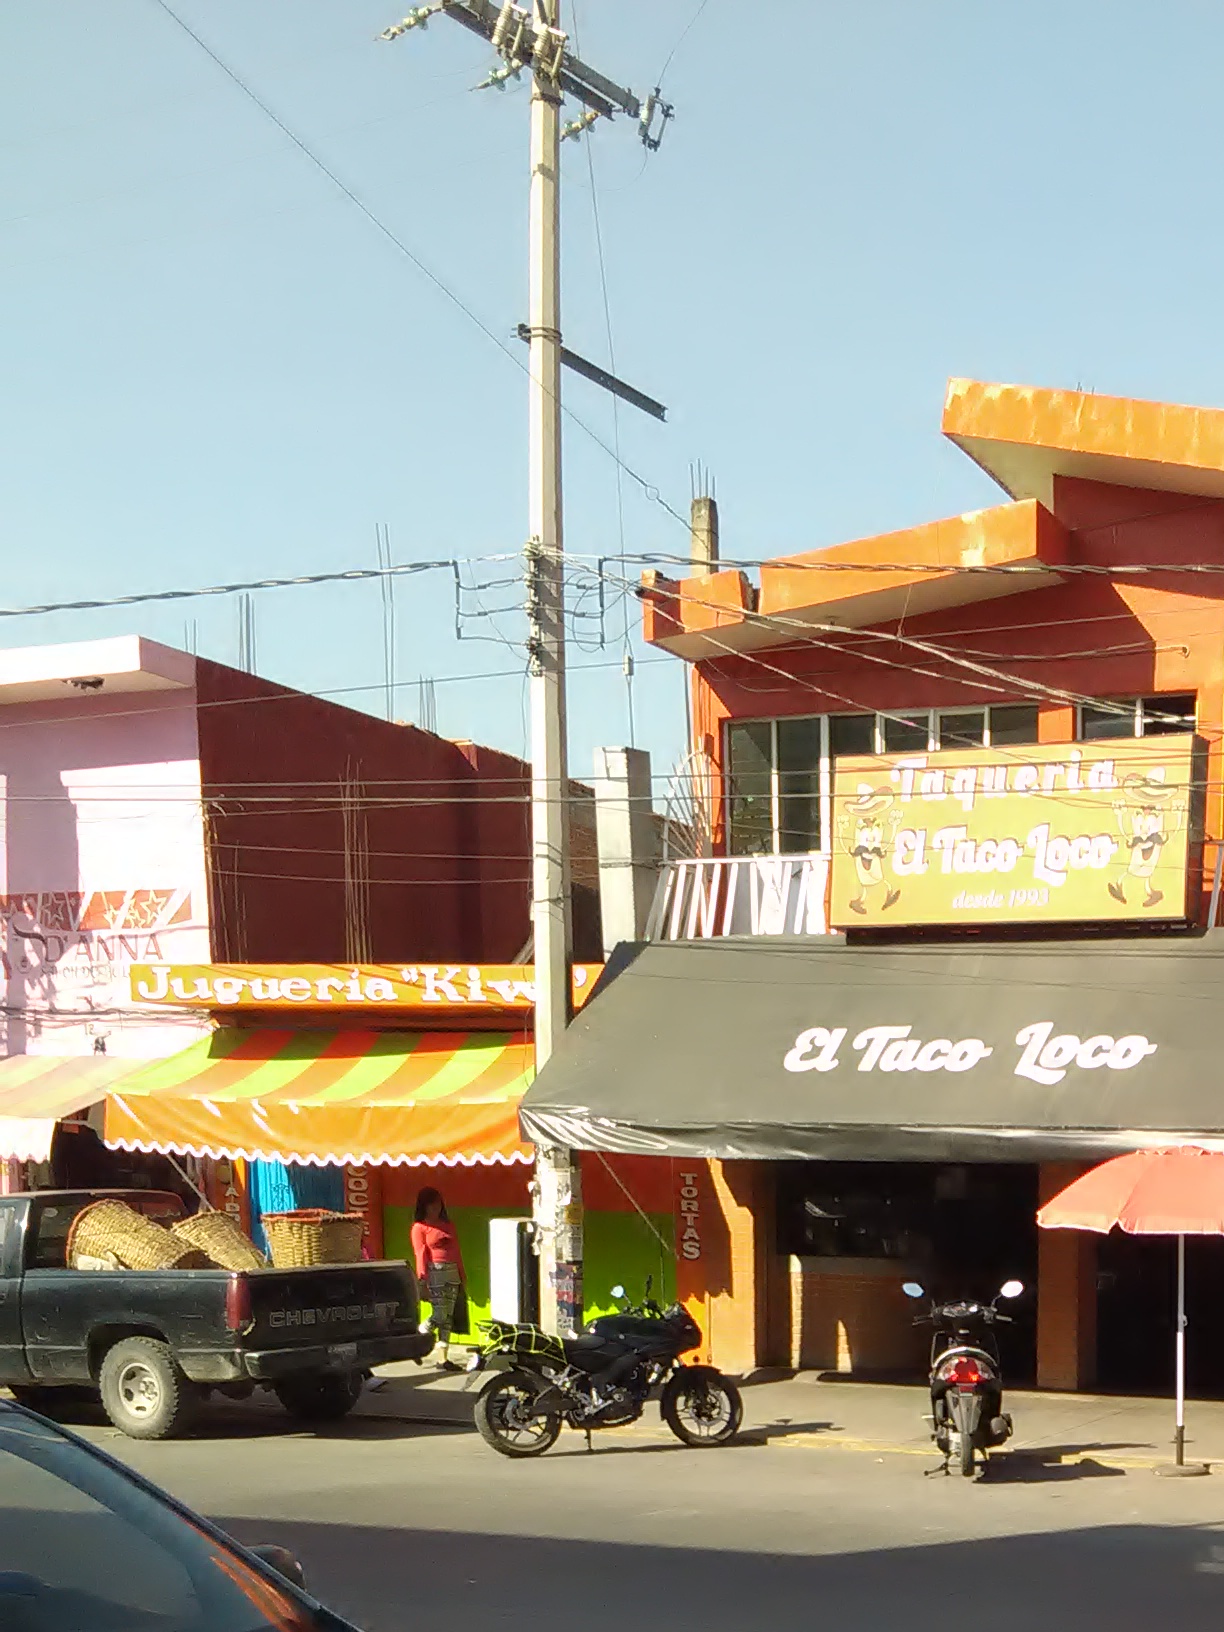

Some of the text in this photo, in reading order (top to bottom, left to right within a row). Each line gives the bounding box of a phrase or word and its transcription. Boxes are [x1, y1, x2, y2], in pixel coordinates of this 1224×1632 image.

[889, 749, 1118, 811] Taqueria
[893, 822, 1120, 887] El Taco Loco
[952, 890, 1004, 909] desde
[784, 1021, 1158, 1085] El Taco Loco
[680, 1172, 700, 1260] TORTAS
[269, 1302, 399, 1328] CHEVROLET
